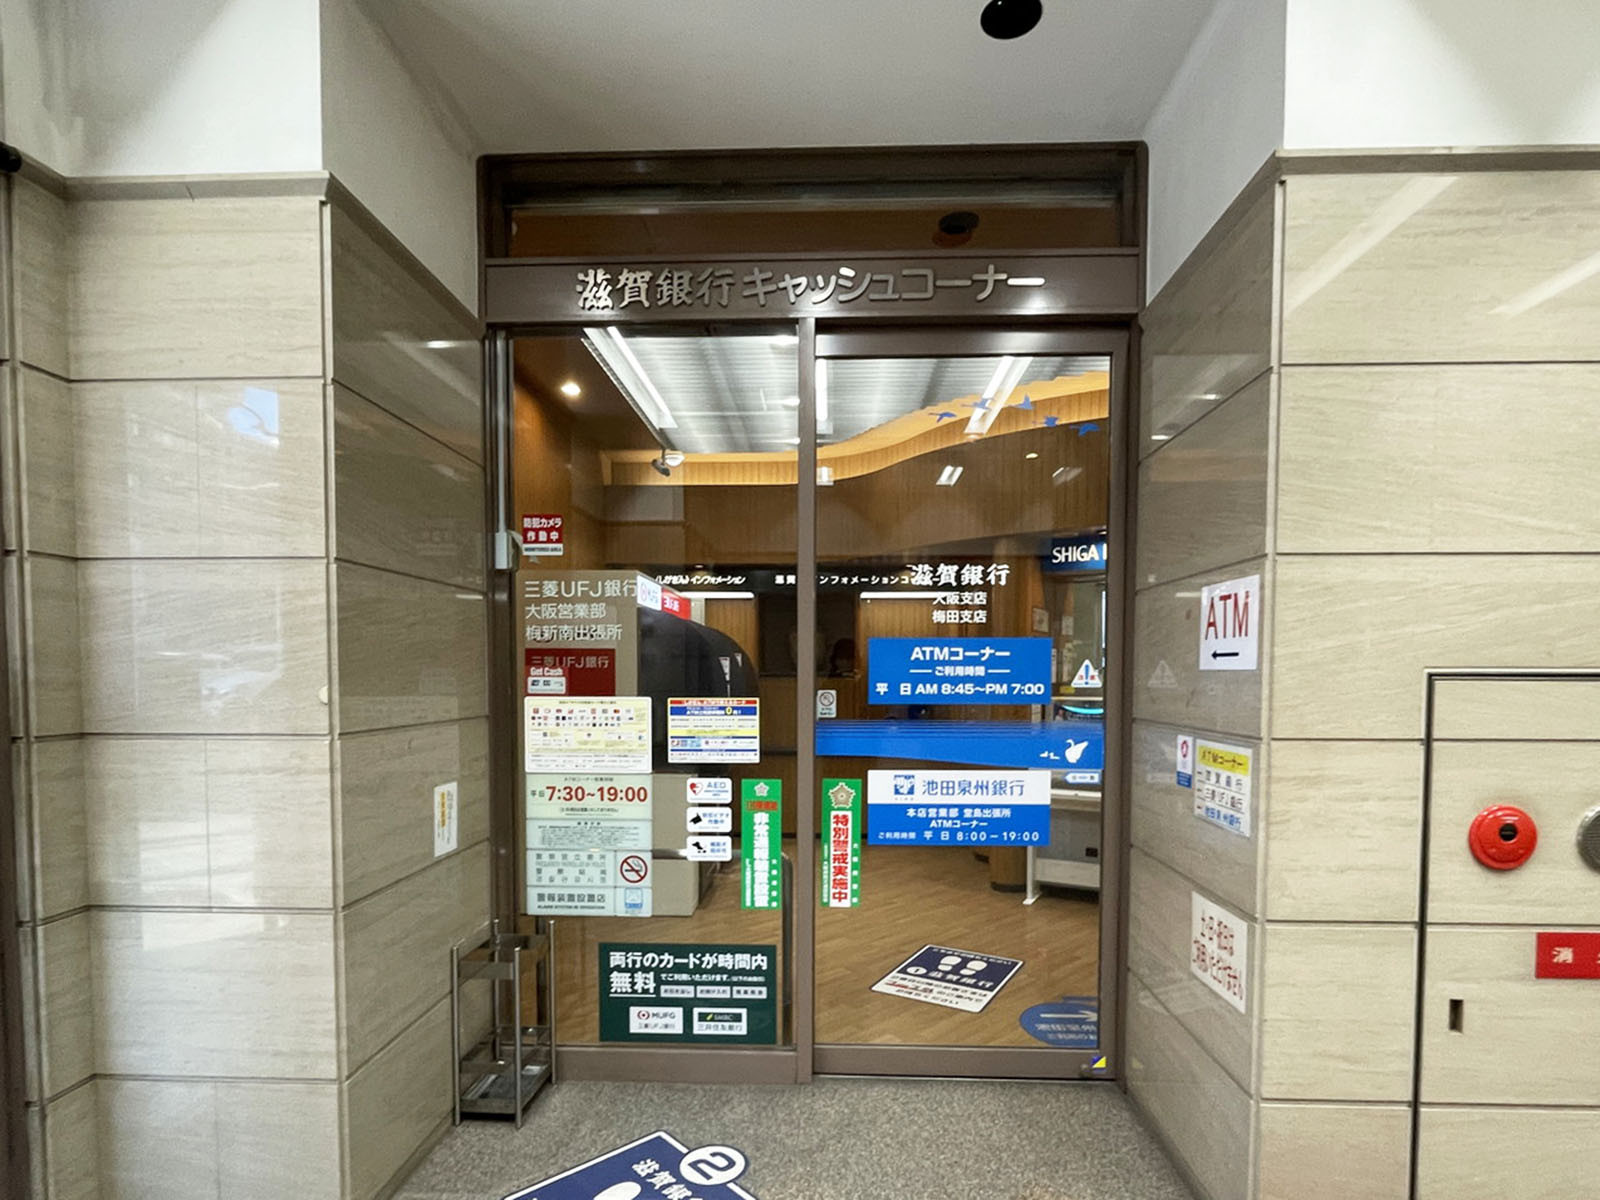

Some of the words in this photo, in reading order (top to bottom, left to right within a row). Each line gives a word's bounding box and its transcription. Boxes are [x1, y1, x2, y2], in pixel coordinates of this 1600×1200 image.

[575, 263, 1046, 311] 滋賀銀行キャッシュコーナー
[523, 517, 562, 528] 防犯カメラ
[527, 530, 559, 542] 作動中
[1052, 544, 1100, 563] SHIGA
[906, 563, 1010, 587] 滋賀銀行
[524, 580, 637, 598] 三菱UFJ銀行
[932, 592, 987, 605] 大阪支店
[525, 603, 607, 618] 大阪営業部
[932, 610, 987, 623] 梅田支店
[1205, 591, 1250, 640] ATM
[525, 624, 623, 641] 梅新南出張所
[910, 647, 1011, 661] ATMコーナー
[531, 656, 609, 669] 三菱UFJ銀行
[935, 665, 986, 676] ご利用時間
[915, 683, 938, 695] AM
[1011, 683, 1044, 695] 7:00
[922, 779, 1025, 797] 池田泉州銀行
[906, 808, 959, 818] 本店営業部
[930, 820, 988, 829] ATMコーナー
[831, 814, 849, 903] 特別警戒実施中
[609, 951, 768, 970] 両行のカードが時間内
[608, 971, 656, 993] 無料
[687, 1152, 736, 1181] 2
